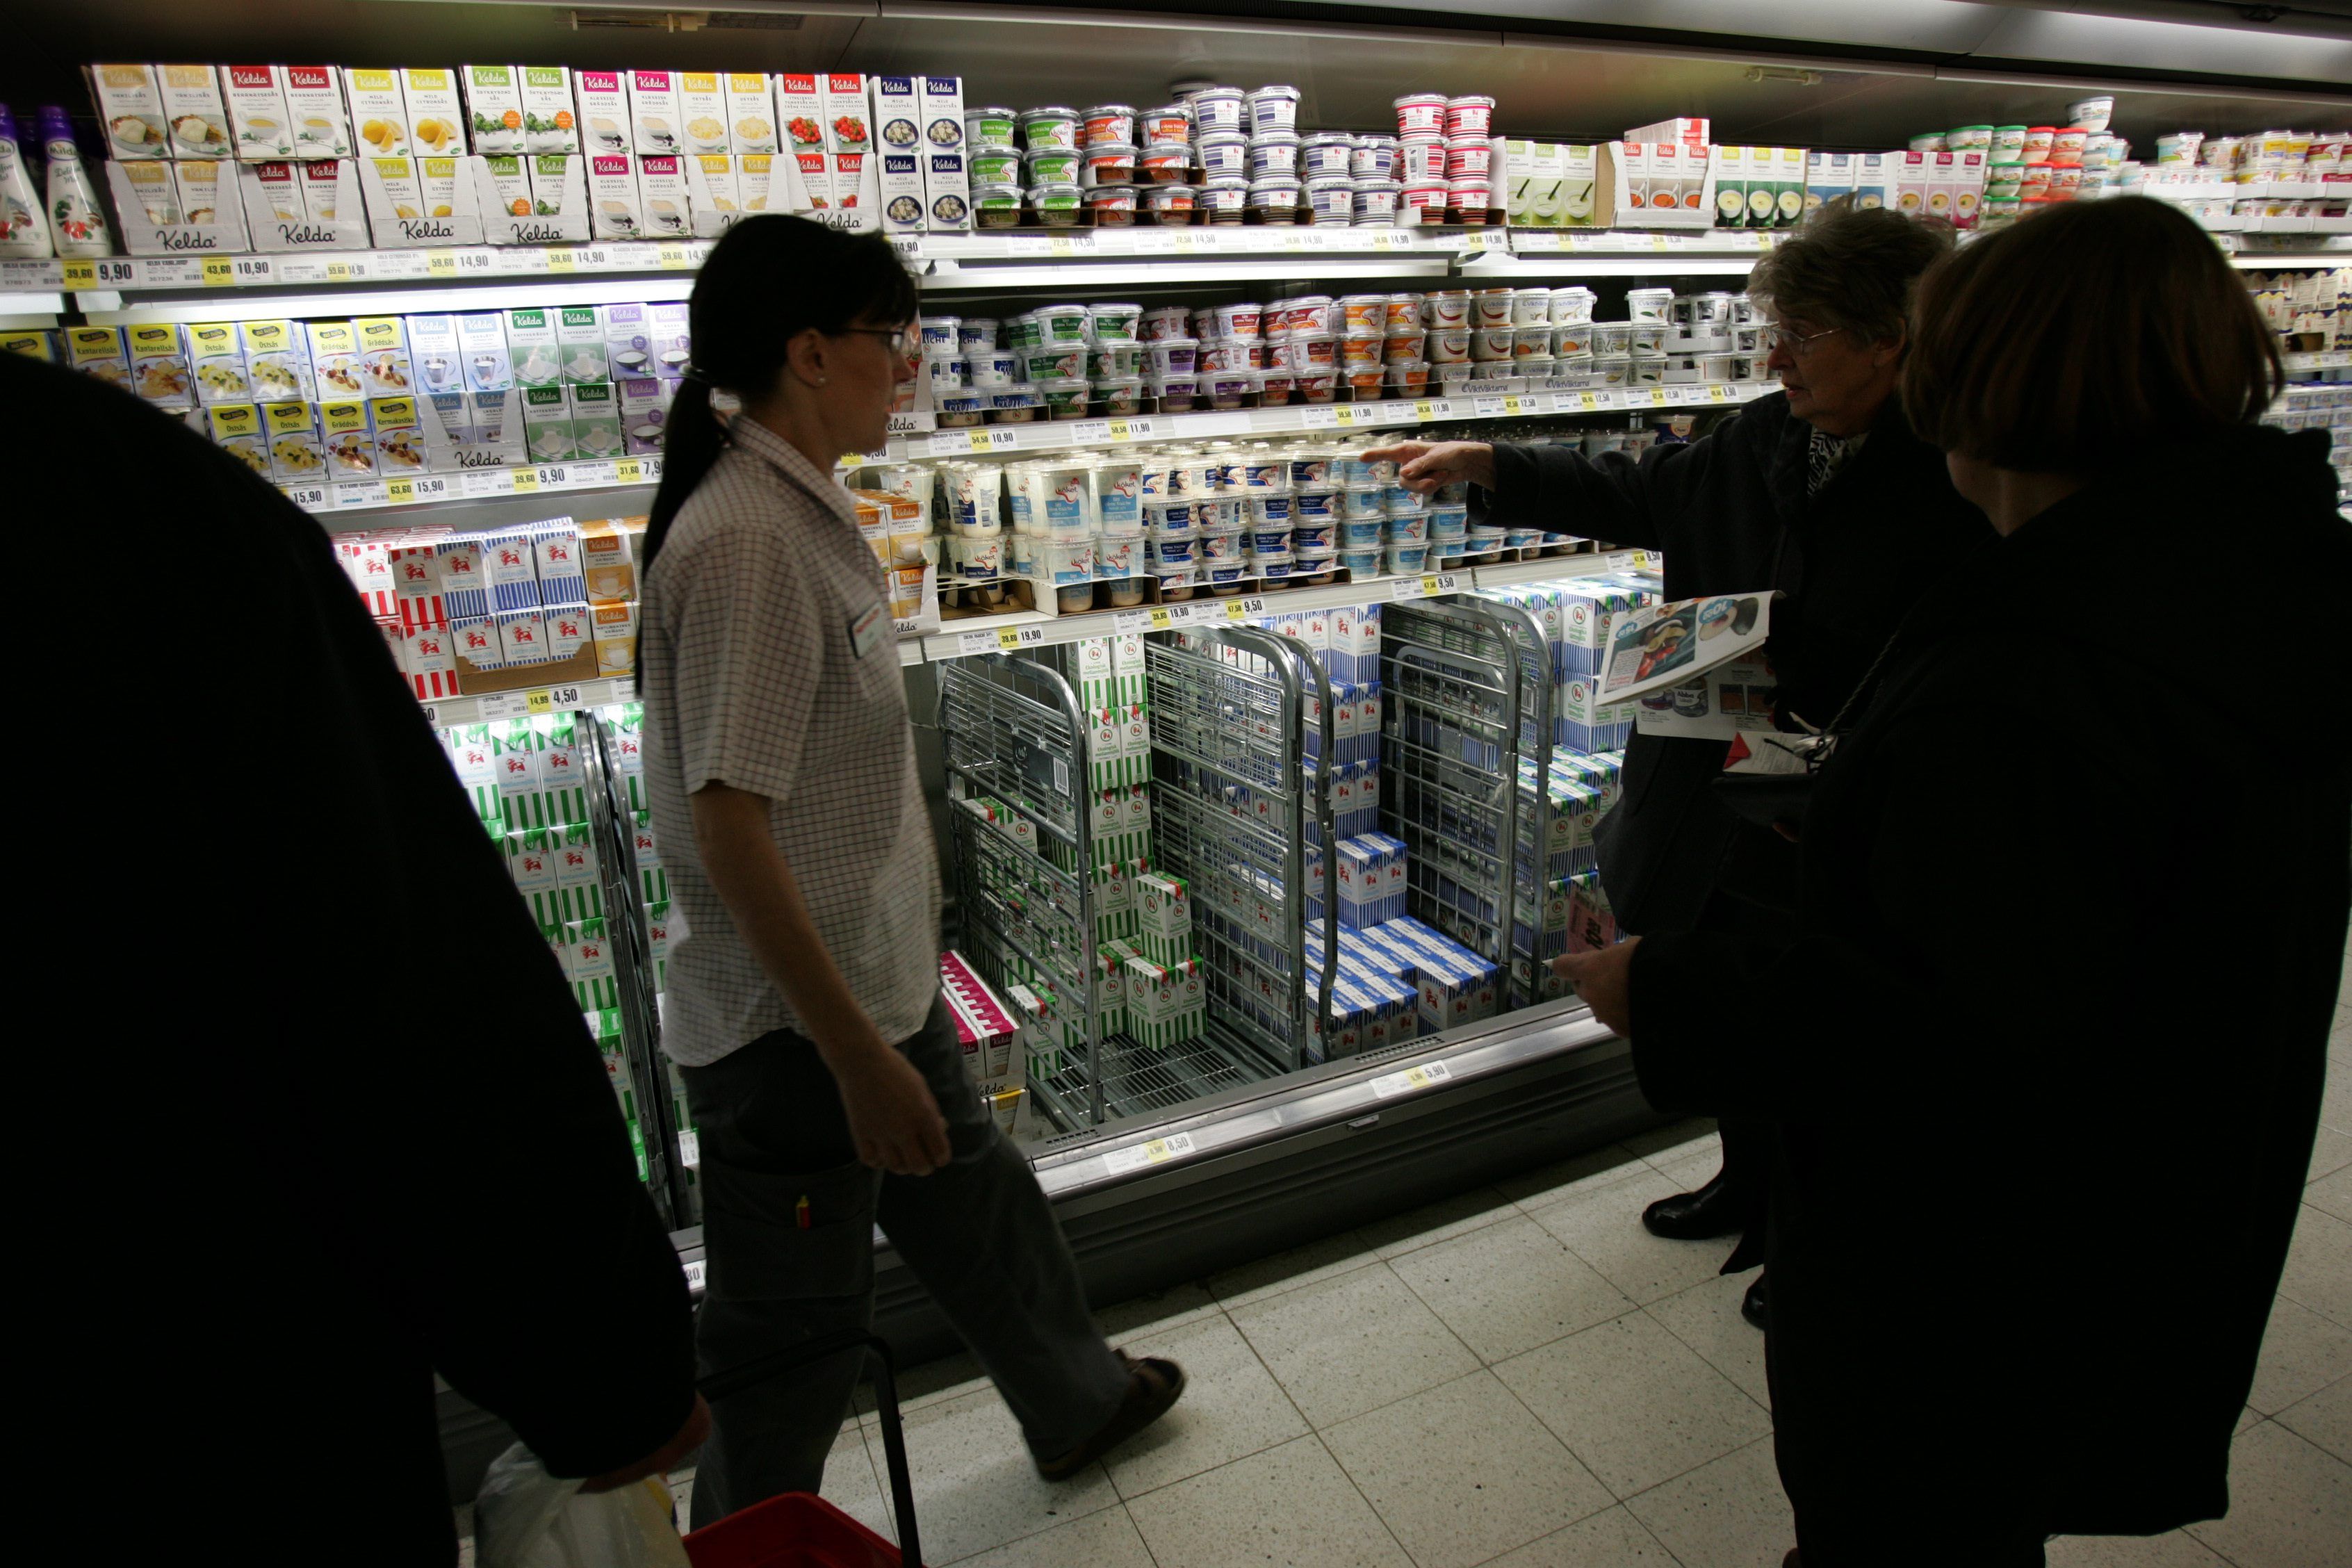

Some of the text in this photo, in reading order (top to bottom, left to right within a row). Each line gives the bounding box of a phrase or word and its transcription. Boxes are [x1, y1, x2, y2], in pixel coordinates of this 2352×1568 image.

[234, 72, 268, 84] Kelda
[291, 72, 325, 85] Kelda
[357, 75, 391, 87] Kelda
[411, 74, 443, 87] Kelda
[475, 70, 506, 84] Kelda
[529, 71, 559, 84] Kelda
[637, 76, 667, 88] Kelda
[585, 77, 615, 90] Kelda
[685, 78, 714, 90] Kelda
[733, 78, 762, 90] Kelda
[786, 79, 813, 91] Kelda
[831, 79, 858, 91] Kelda
[883, 81, 909, 93] Kelda
[928, 81, 954, 93] Kelda
[596, 161, 625, 172] Kelda
[645, 161, 674, 172] Kelda
[887, 158, 913, 171] Kelda
[933, 157, 958, 170] Kelda
[279, 224, 335, 244] Kelda
[399, 220, 454, 240] Kelda
[511, 224, 563, 243] Kelda
[156, 229, 217, 251] Kelda
[1195, 234, 1216, 245] 14,50
[1391, 235, 1409, 244] 14,90
[895, 242, 918, 252] 14,90
[432, 256, 489, 268] 59,60 14,90
[550, 252, 605, 263] 59,60 14,90
[687, 251, 710, 261] 14,9
[67, 264, 132, 281] 39,60 9,90
[207, 262, 269, 275] 43,60 10,90
[514, 317, 541, 325] Kelda
[564, 314, 591, 323] Kelda
[612, 311, 637, 319] Kelda
[417, 322, 445, 332] Kelda
[466, 320, 493, 329] Kelda
[531, 392, 557, 401] Kelda
[579, 389, 605, 399] Kelda
[1521, 399, 1536, 407] 12,50
[1355, 408, 1371, 418] 11,90
[1130, 423, 1150, 434] 11,90
[993, 432, 1013, 443] 10,90
[455, 452, 504, 468] Kelda
[620, 460, 661, 475] 31,60 7,9
[515, 468, 565, 484] 39,60 9,90
[391, 480, 443, 495] 63,60 15,90
[293, 491, 322, 504] 15,90
[893, 507, 916, 517] Kelda
[1439, 578, 1454, 588] 9,50
[1245, 600, 1262, 612] 9,50
[1170, 607, 1189, 618] 19,90
[895, 622, 917, 633] elda
[1021, 630, 1041, 641] 19,90
[553, 689, 578, 704] 4,50
[1426, 1065, 1445, 1078] 5,90
[979, 1082, 1006, 1097] elda
[1167, 1137, 1189, 1151] 8,50
